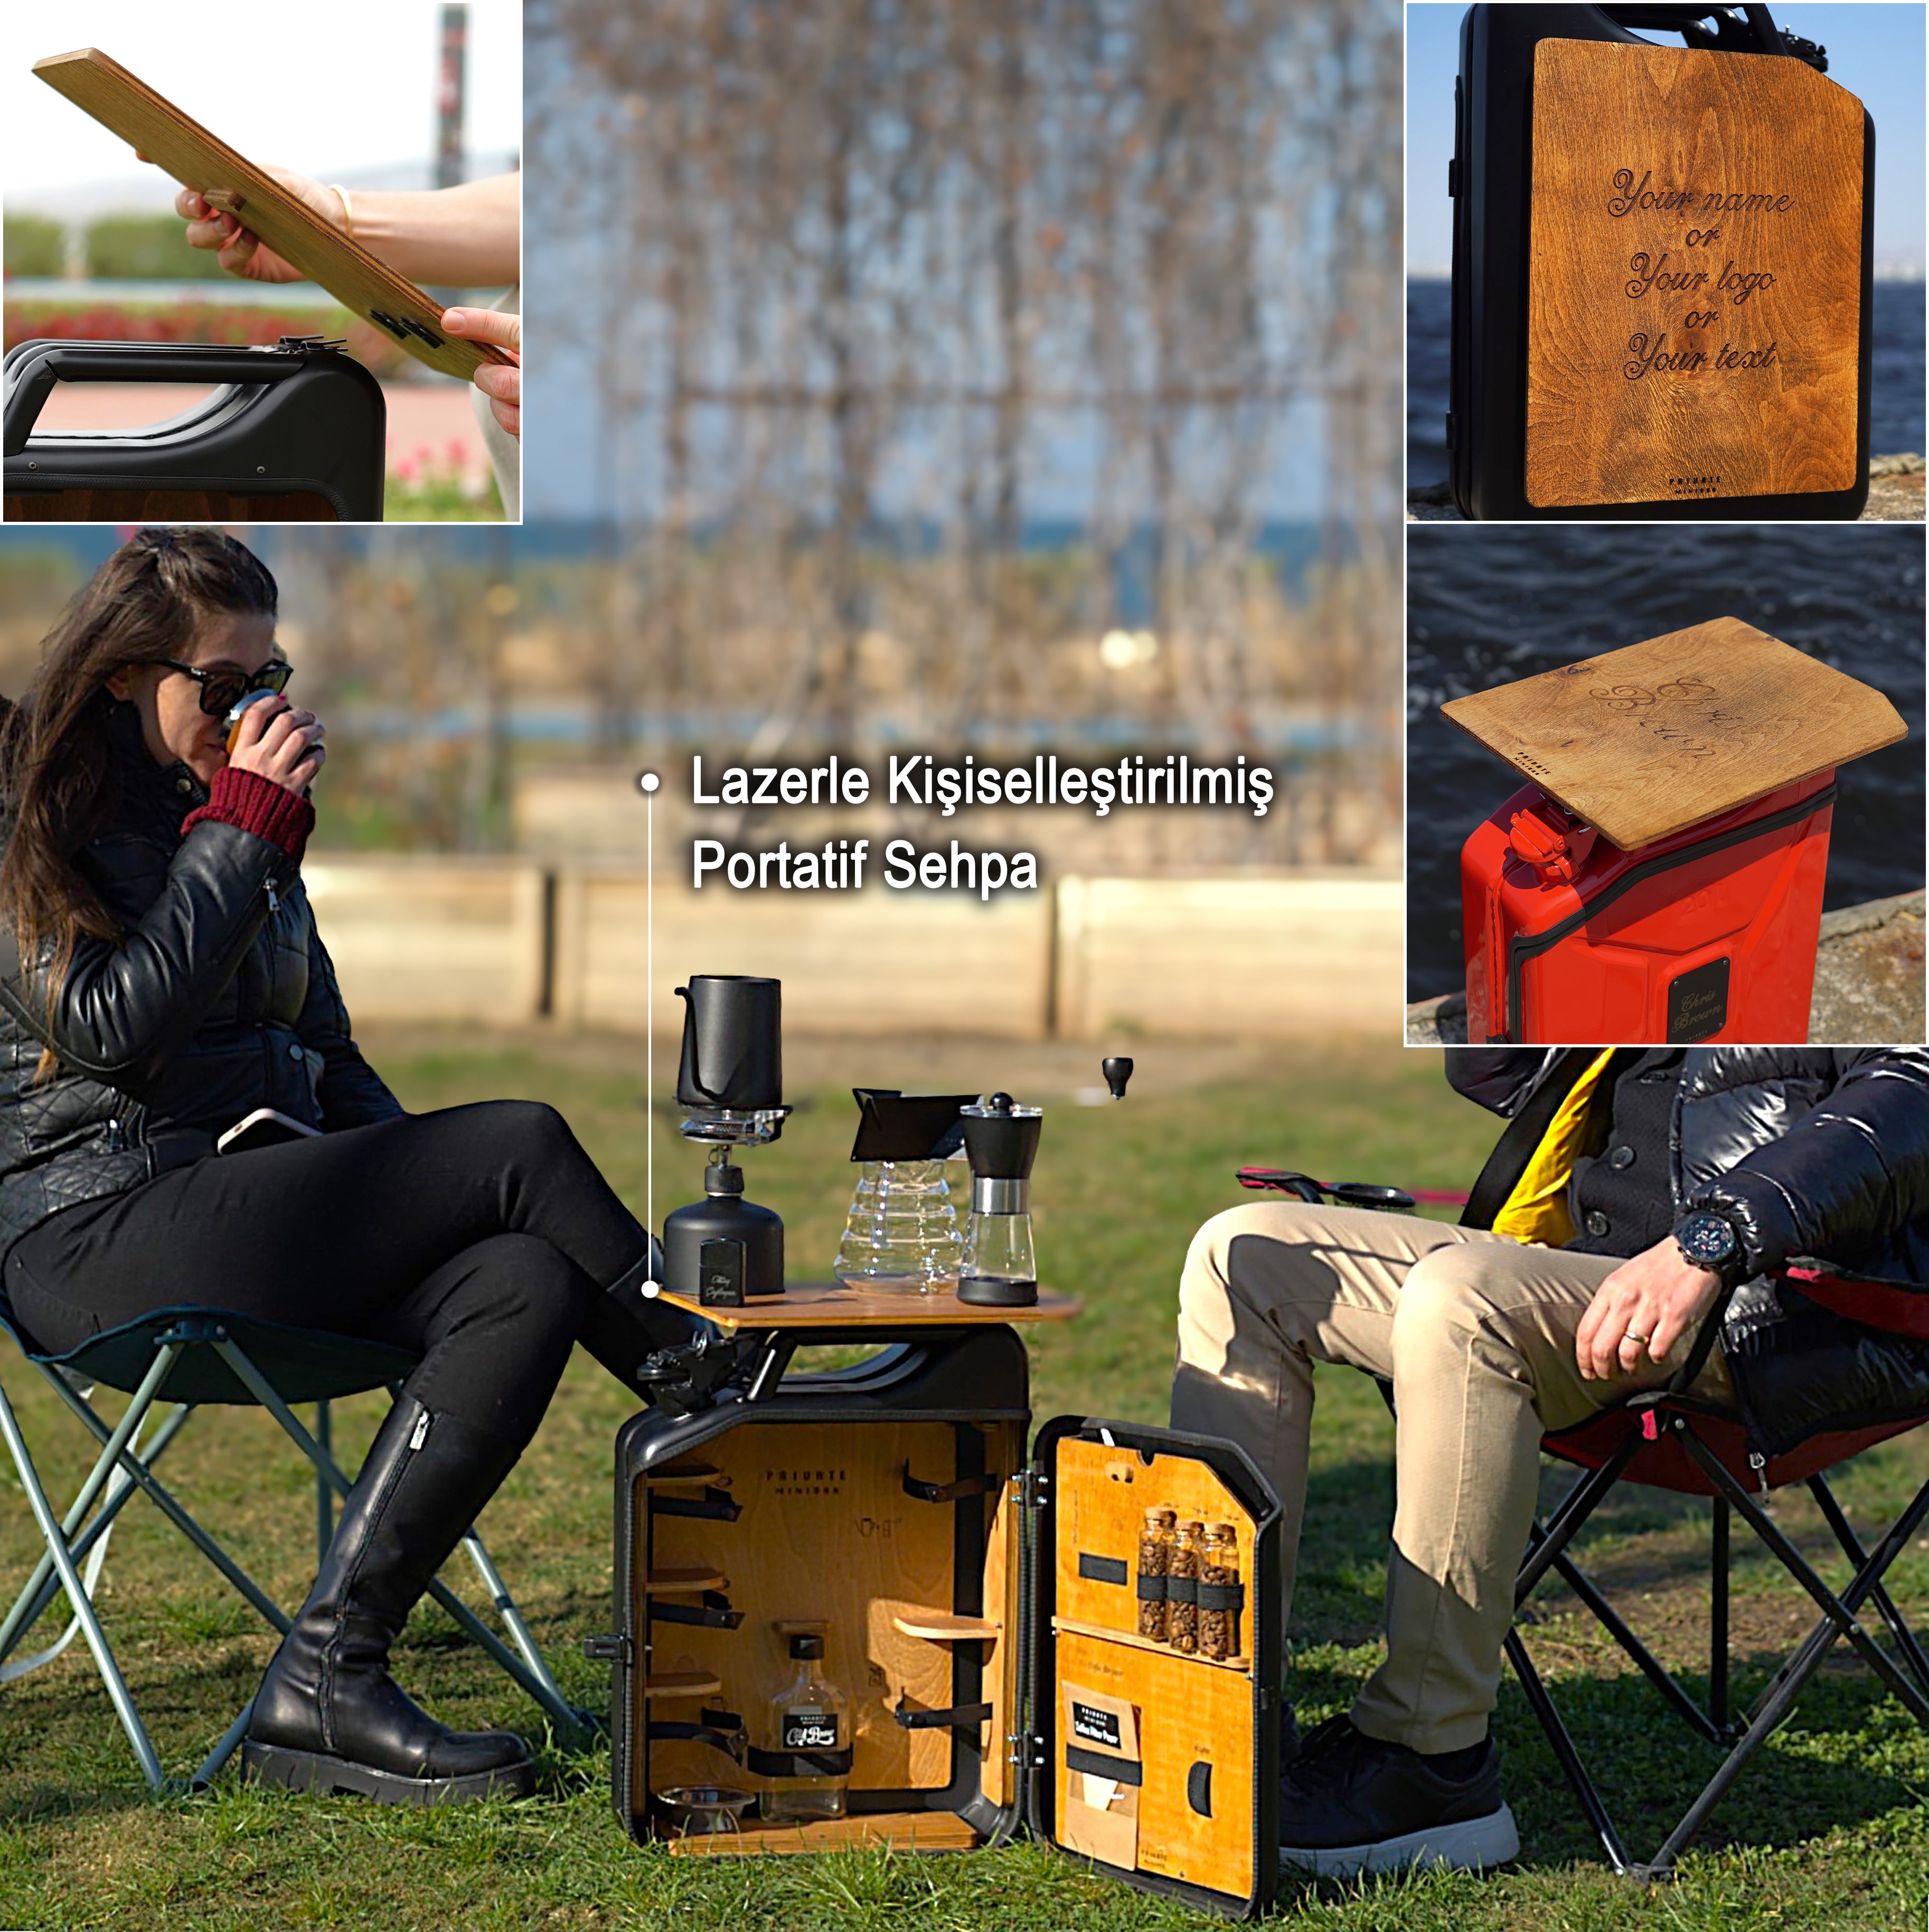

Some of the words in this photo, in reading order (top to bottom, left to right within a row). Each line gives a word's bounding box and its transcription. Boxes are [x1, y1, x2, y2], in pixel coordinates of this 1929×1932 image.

[1608, 168, 1694, 218] Your
[1704, 193, 1795, 212] name
[1686, 229, 1720, 247] or
[1625, 252, 1709, 298] Your
[1717, 260, 1777, 305] logo
[1685, 311, 1719, 329] or
[1624, 333, 1708, 380] Your
[1716, 342, 1777, 370] text
[1681, 990, 1716, 1012] Chris
[1671, 1005, 1723, 1033] Brown
